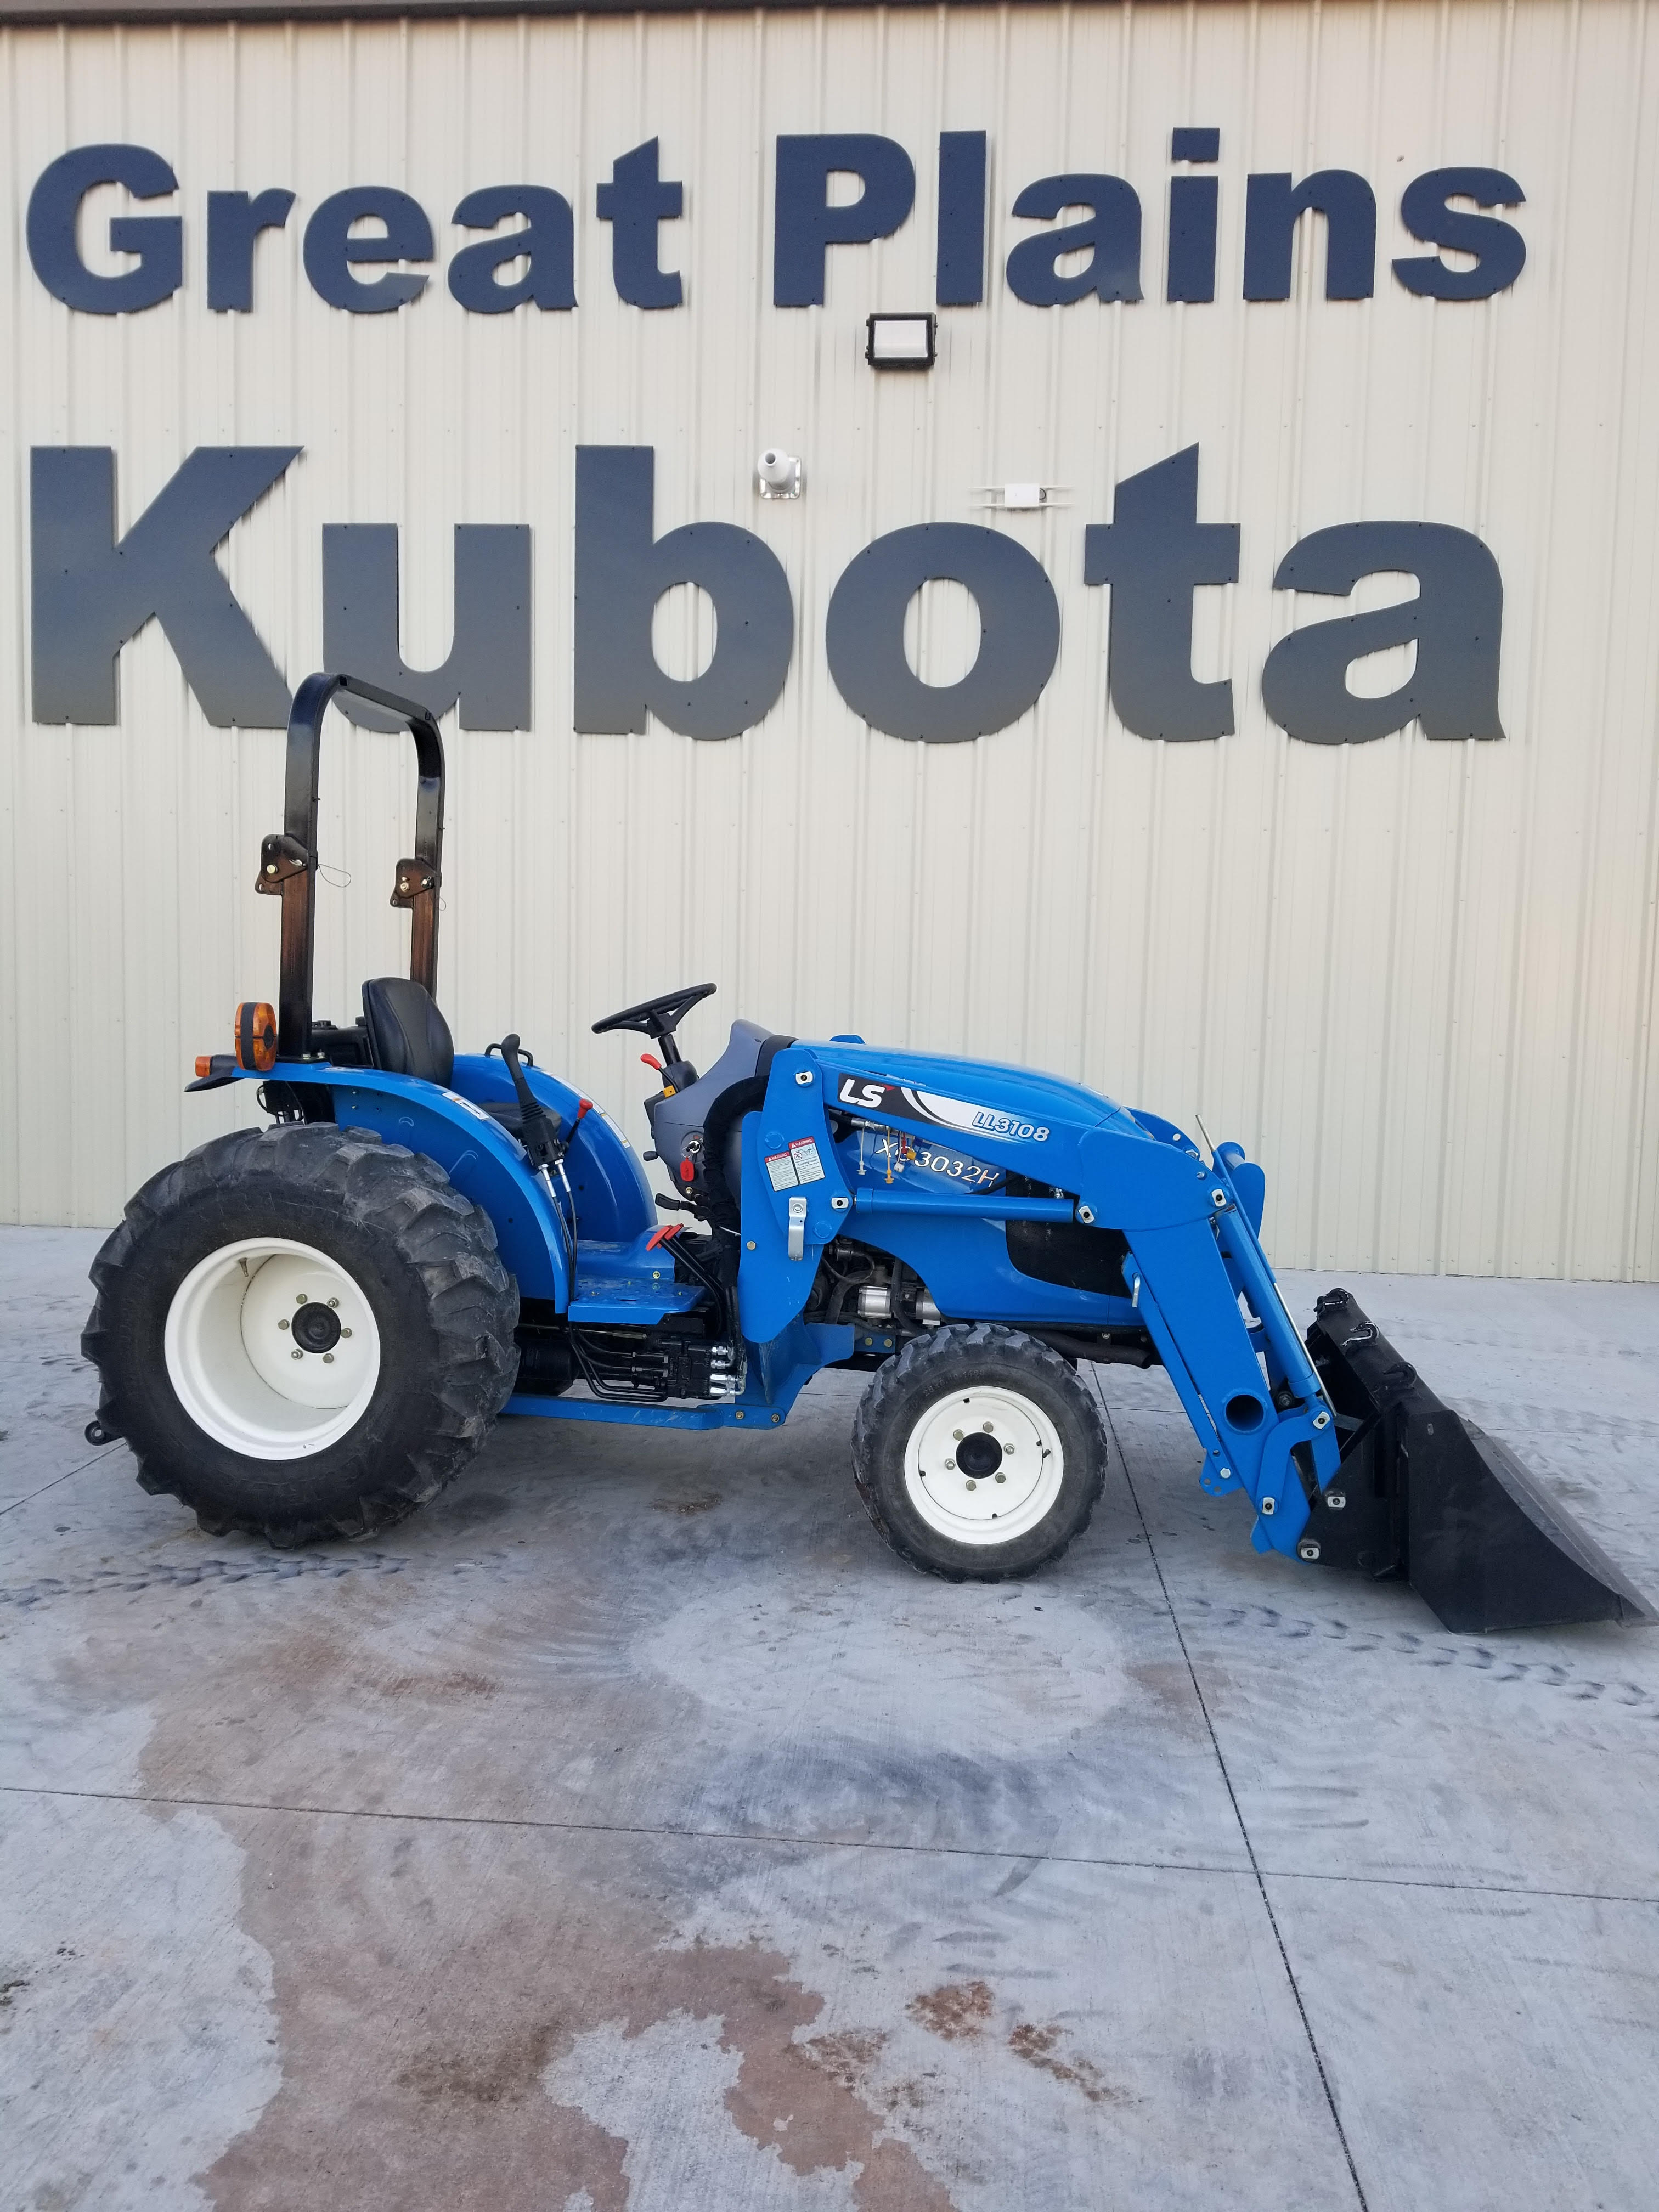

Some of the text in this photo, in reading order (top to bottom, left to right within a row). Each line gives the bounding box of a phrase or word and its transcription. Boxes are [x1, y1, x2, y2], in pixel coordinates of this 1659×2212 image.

[27, 127, 1526, 317] Great Plains
[30, 443, 1506, 746] Kubota
[839, 1079, 885, 1108] LS
[972, 1111, 1051, 1142] LL3108
